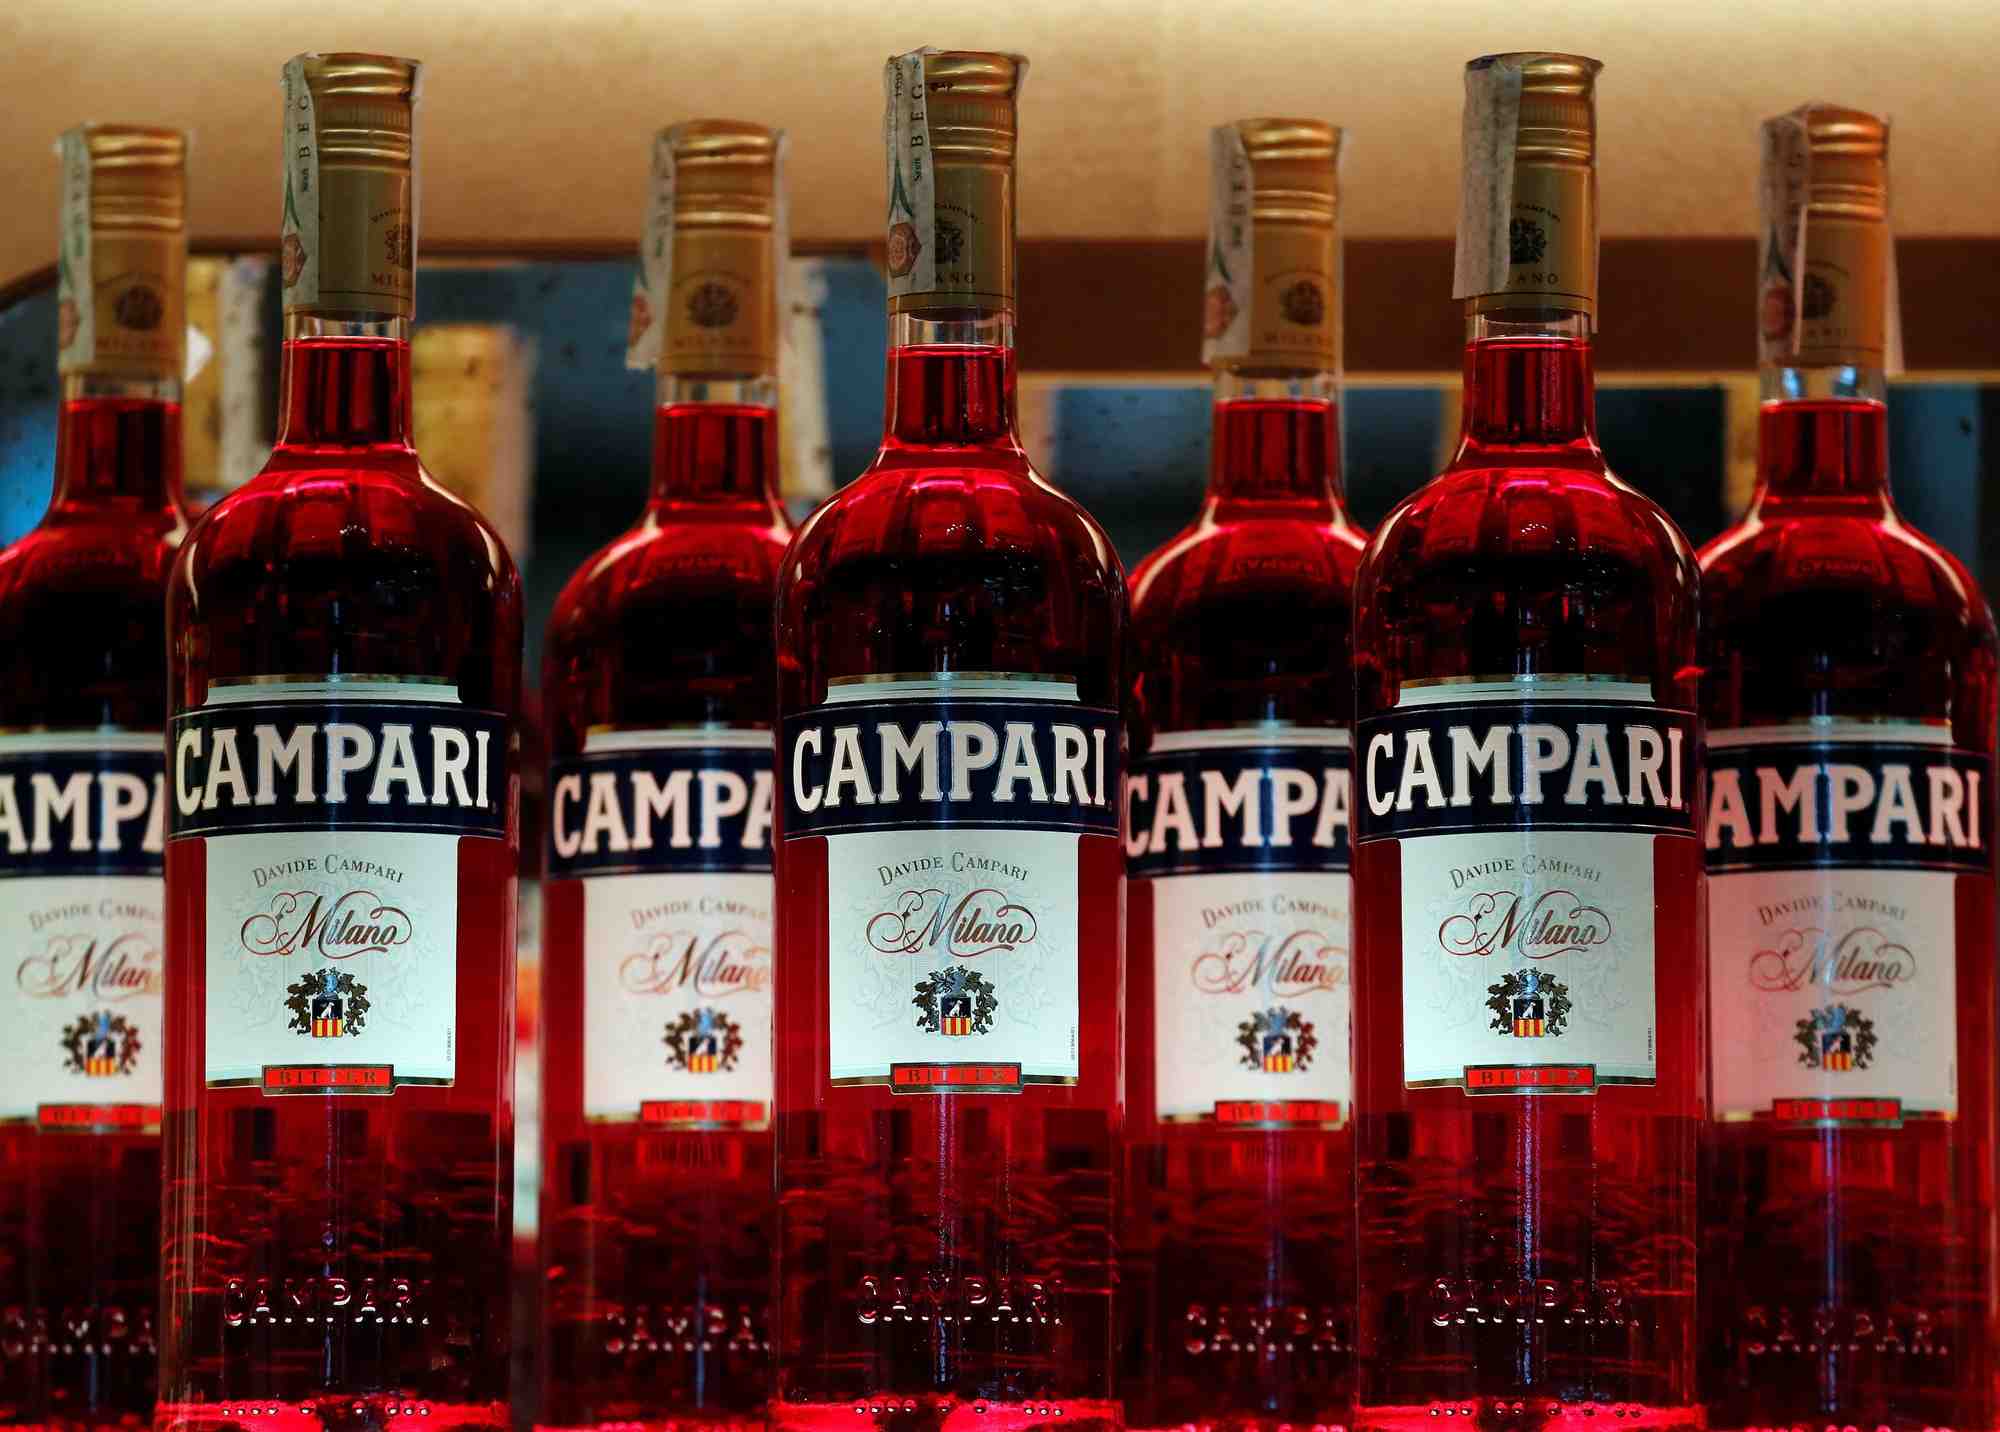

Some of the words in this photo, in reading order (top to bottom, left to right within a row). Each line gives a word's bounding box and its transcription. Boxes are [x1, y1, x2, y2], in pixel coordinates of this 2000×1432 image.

[175, 722, 490, 816] CAMPARI
[792, 721, 1106, 814] CAMPARI
[1366, 723, 1683, 816] CAMPARI
[252, 858, 318, 888] DAVIDE
[324, 853, 407, 883] CAMPARI
[877, 856, 943, 887] DAVIDE
[951, 851, 1029, 881] CAMPARI
[1449, 858, 1515, 889] DAVIDE
[1521, 854, 1602, 882] CAMPARI
[240, 889, 412, 960] Milano
[866, 888, 1037, 957] Milano
[1438, 890, 1612, 959] Milano
